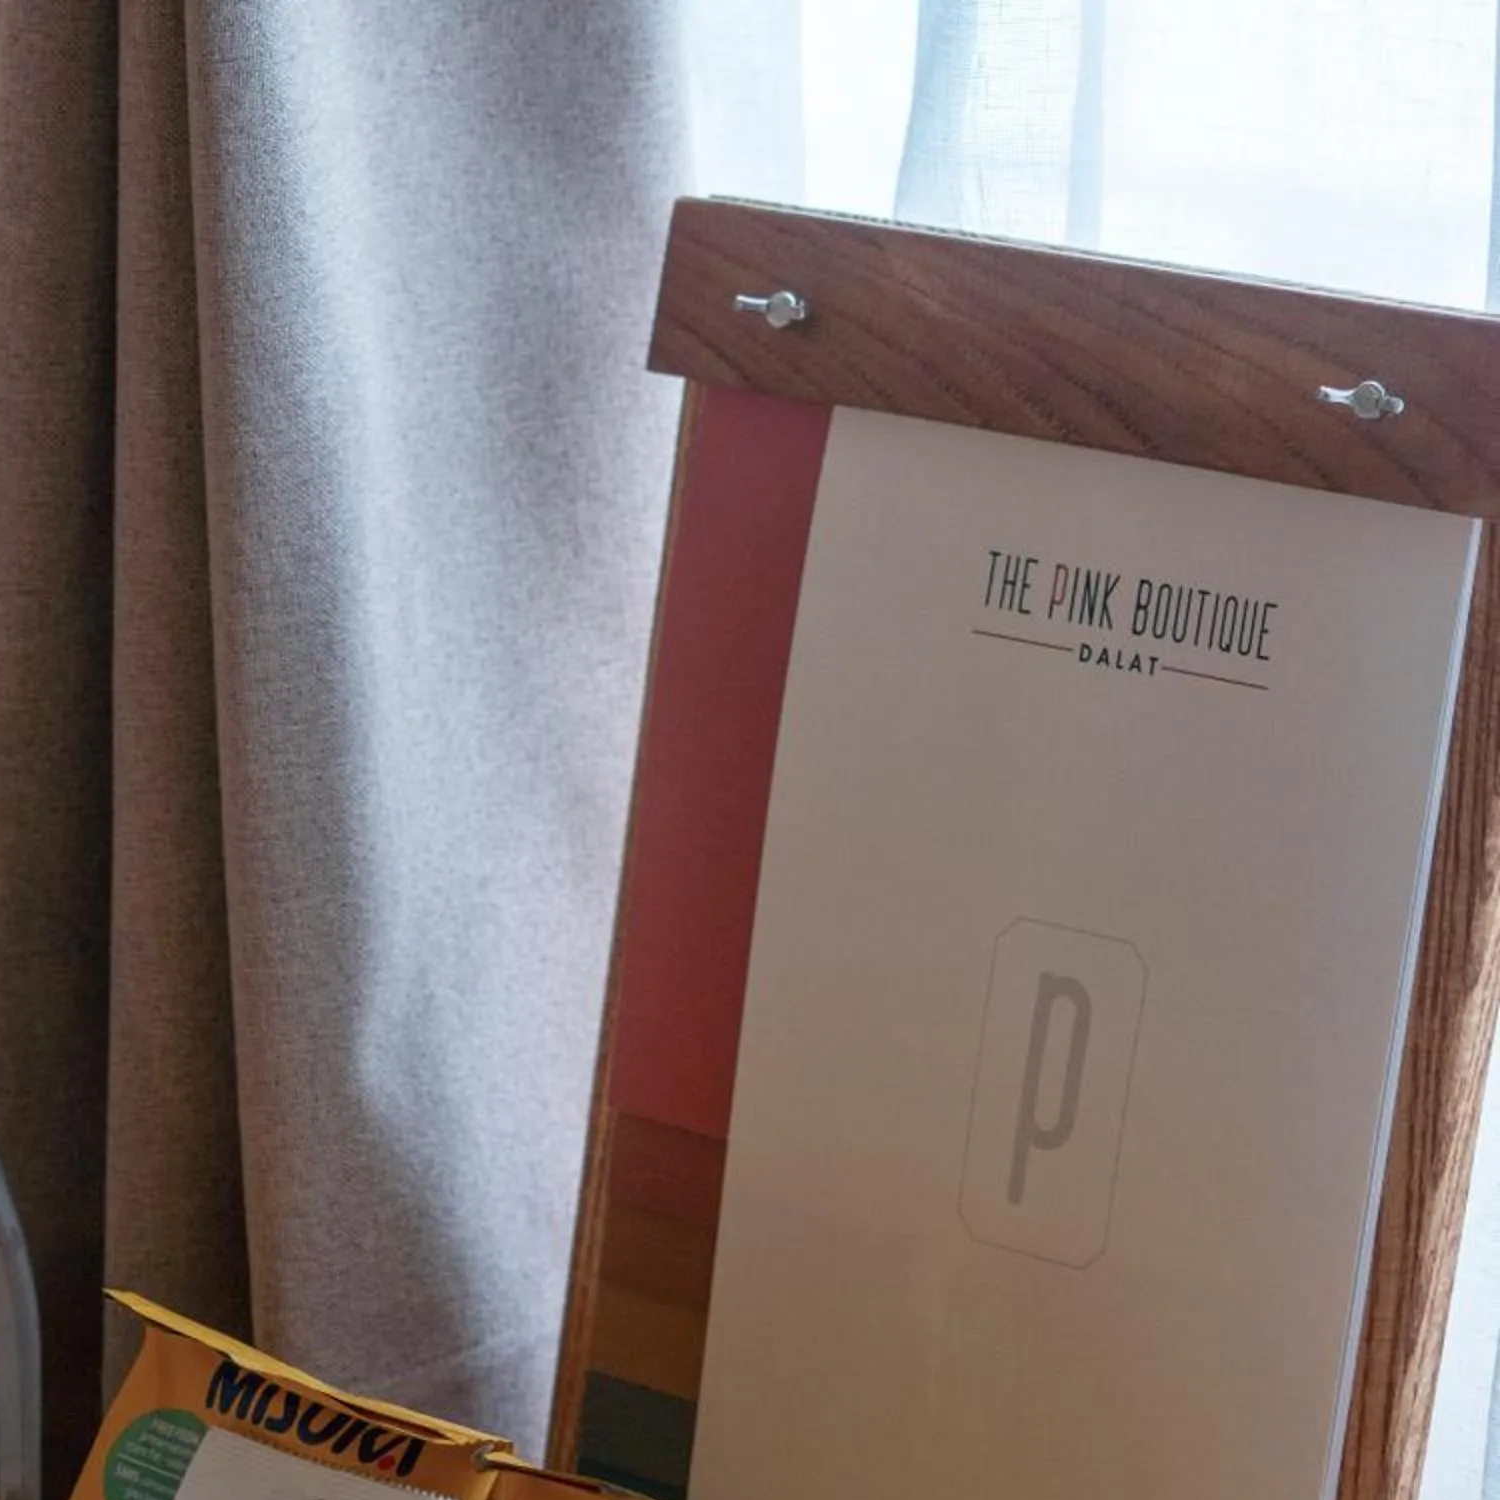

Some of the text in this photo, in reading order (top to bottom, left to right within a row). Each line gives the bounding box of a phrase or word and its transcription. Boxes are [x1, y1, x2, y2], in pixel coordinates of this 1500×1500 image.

[984, 551, 1279, 662] THE PINK BOUTIQUE
[1078, 643, 1160, 676] DALAT
